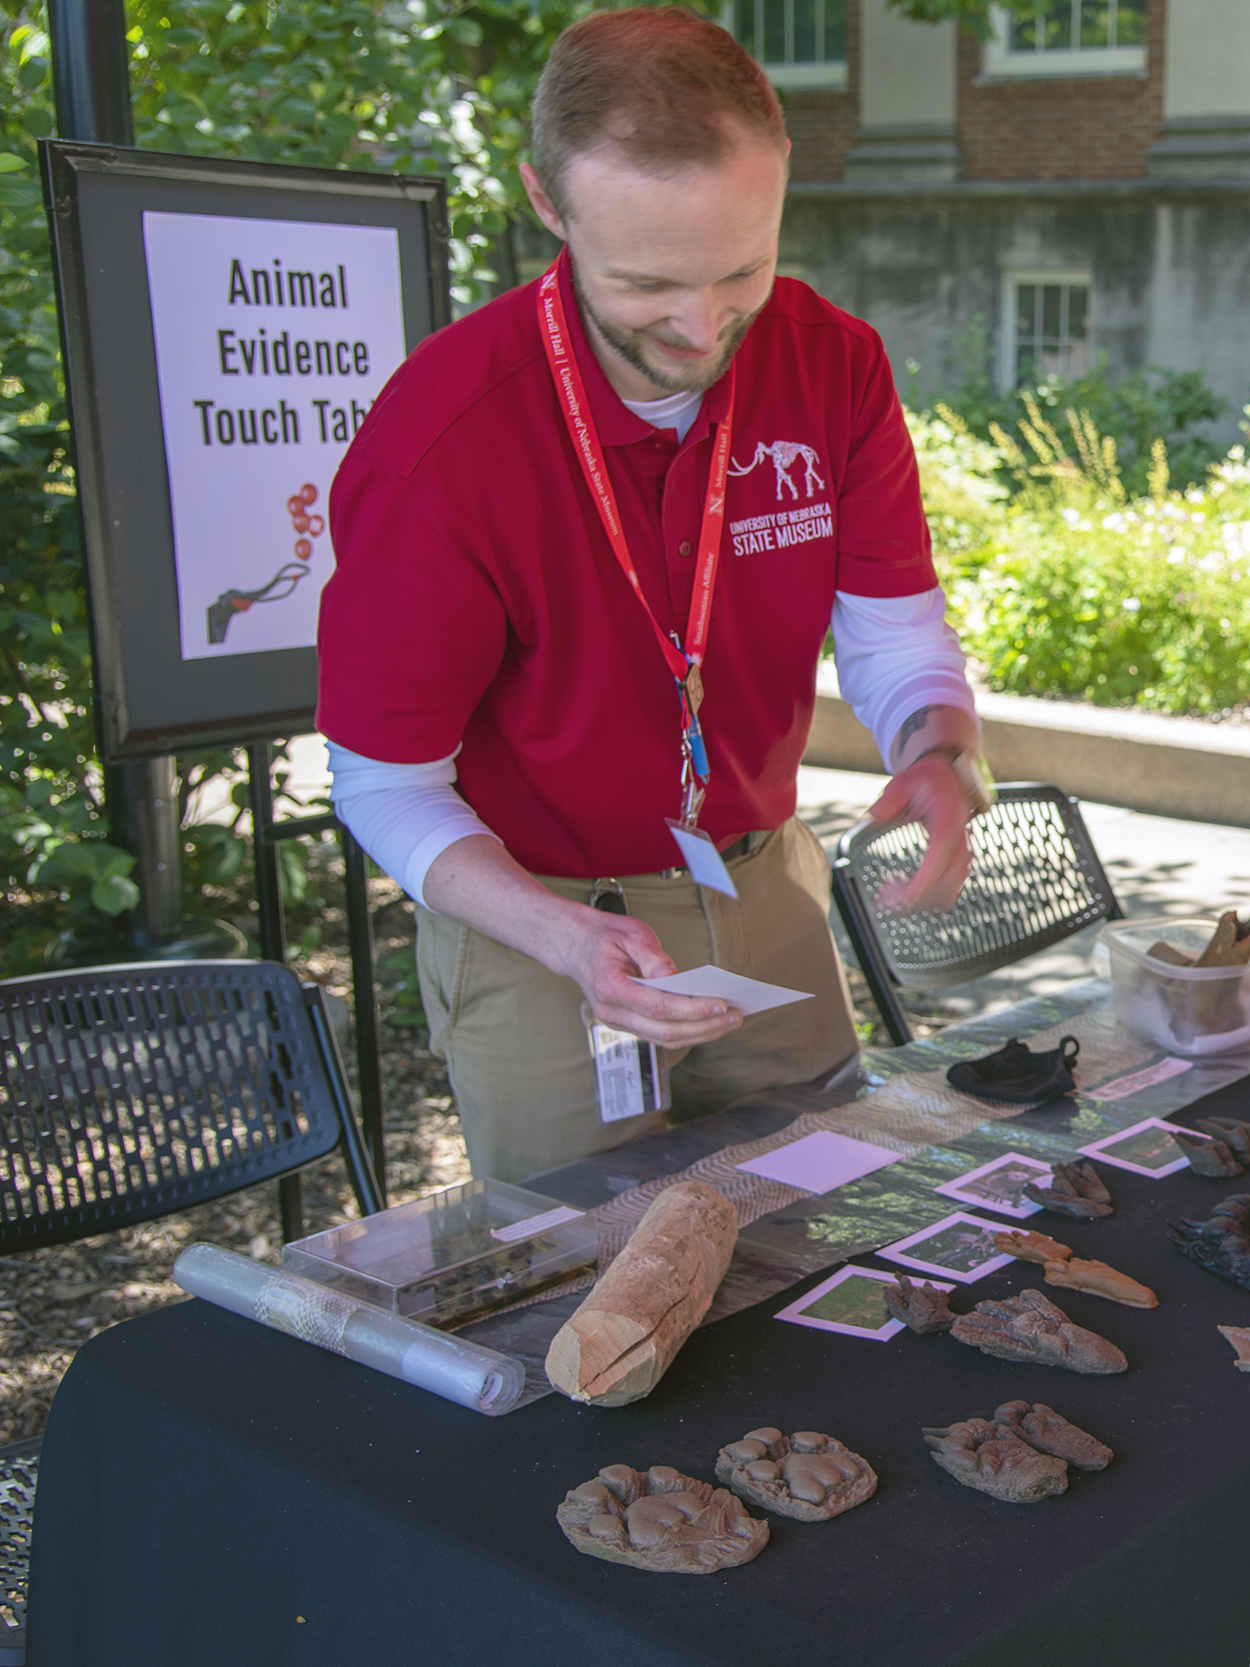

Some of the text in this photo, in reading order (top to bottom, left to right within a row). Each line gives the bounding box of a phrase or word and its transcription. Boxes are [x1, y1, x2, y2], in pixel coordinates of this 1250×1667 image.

[228, 258, 348, 308] Animal
[543, 297, 560, 333] Morrill
[217, 328, 370, 376] Evidence
[550, 334, 566, 356] Hall
[560, 367, 580, 416] University
[194, 398, 375, 446] Touch Tab
[574, 417, 587, 430] of
[577, 428, 597, 472] Nebraska
[719, 433, 727, 453] Hall
[592, 472, 604, 495] State
[715, 454, 726, 488] Morrill
[601, 495, 618, 536] Museum
[729, 502, 832, 535] UNIVERSITY OF NEBRASKA
[732, 516, 833, 557] STATE MUSEUM
